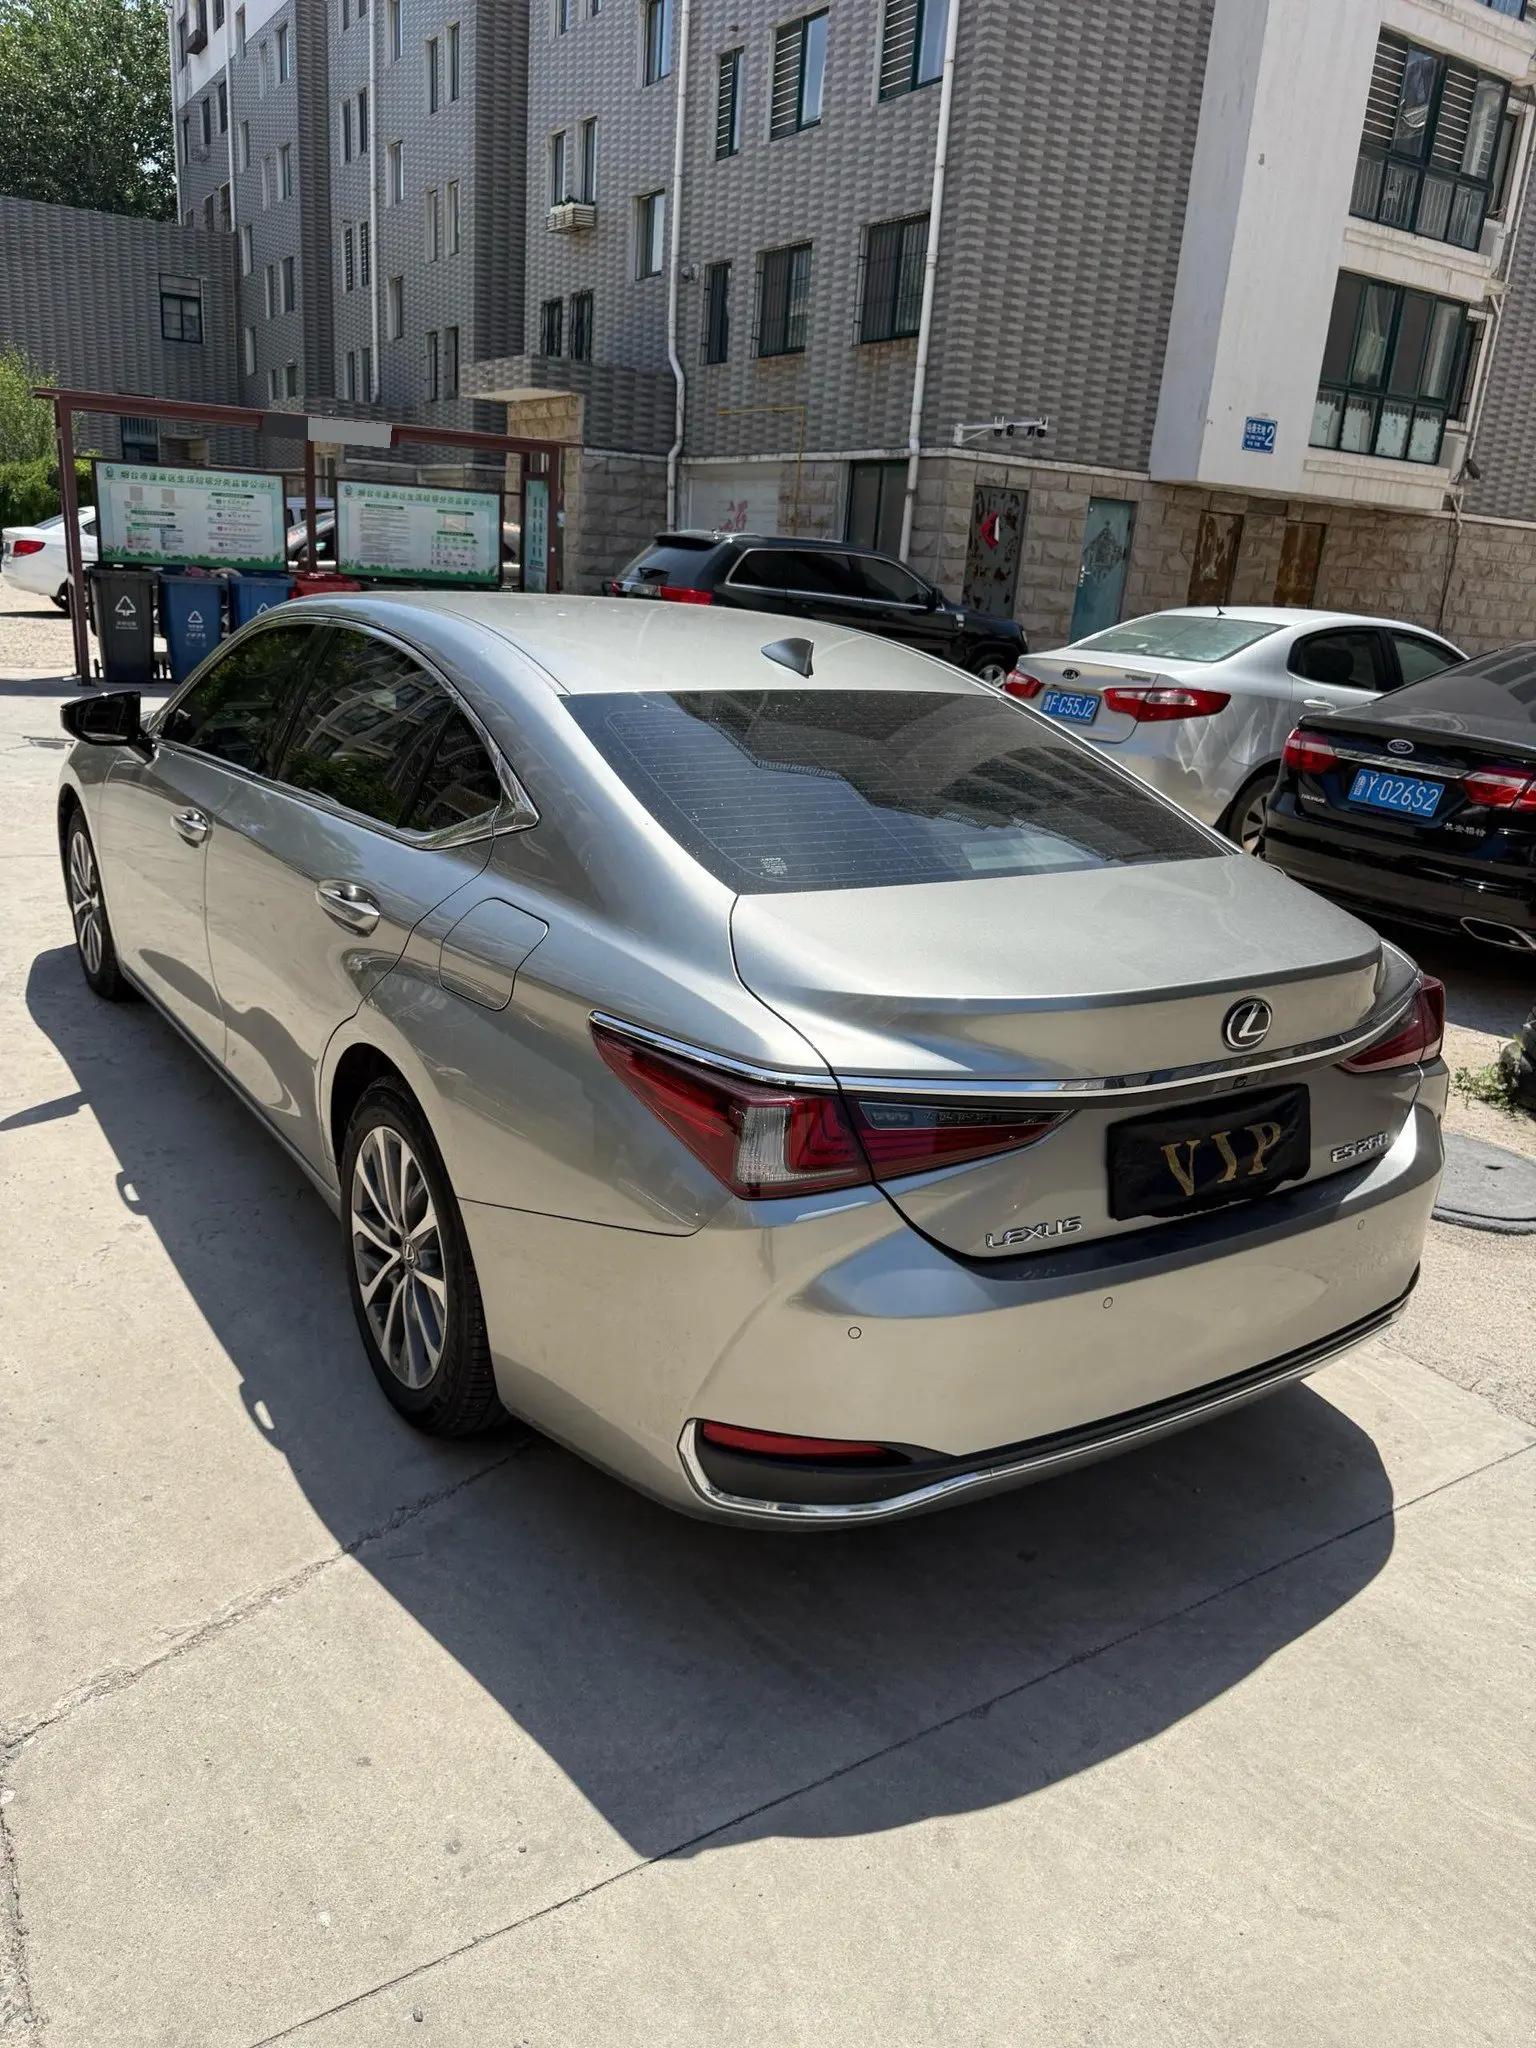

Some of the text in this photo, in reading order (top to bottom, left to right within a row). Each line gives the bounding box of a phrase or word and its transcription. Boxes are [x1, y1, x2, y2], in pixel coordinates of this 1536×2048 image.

[1264, 425, 1275, 447] 2
[1160, 1122, 1282, 1197] VIP
[985, 1216, 1082, 1248] LEXUS
